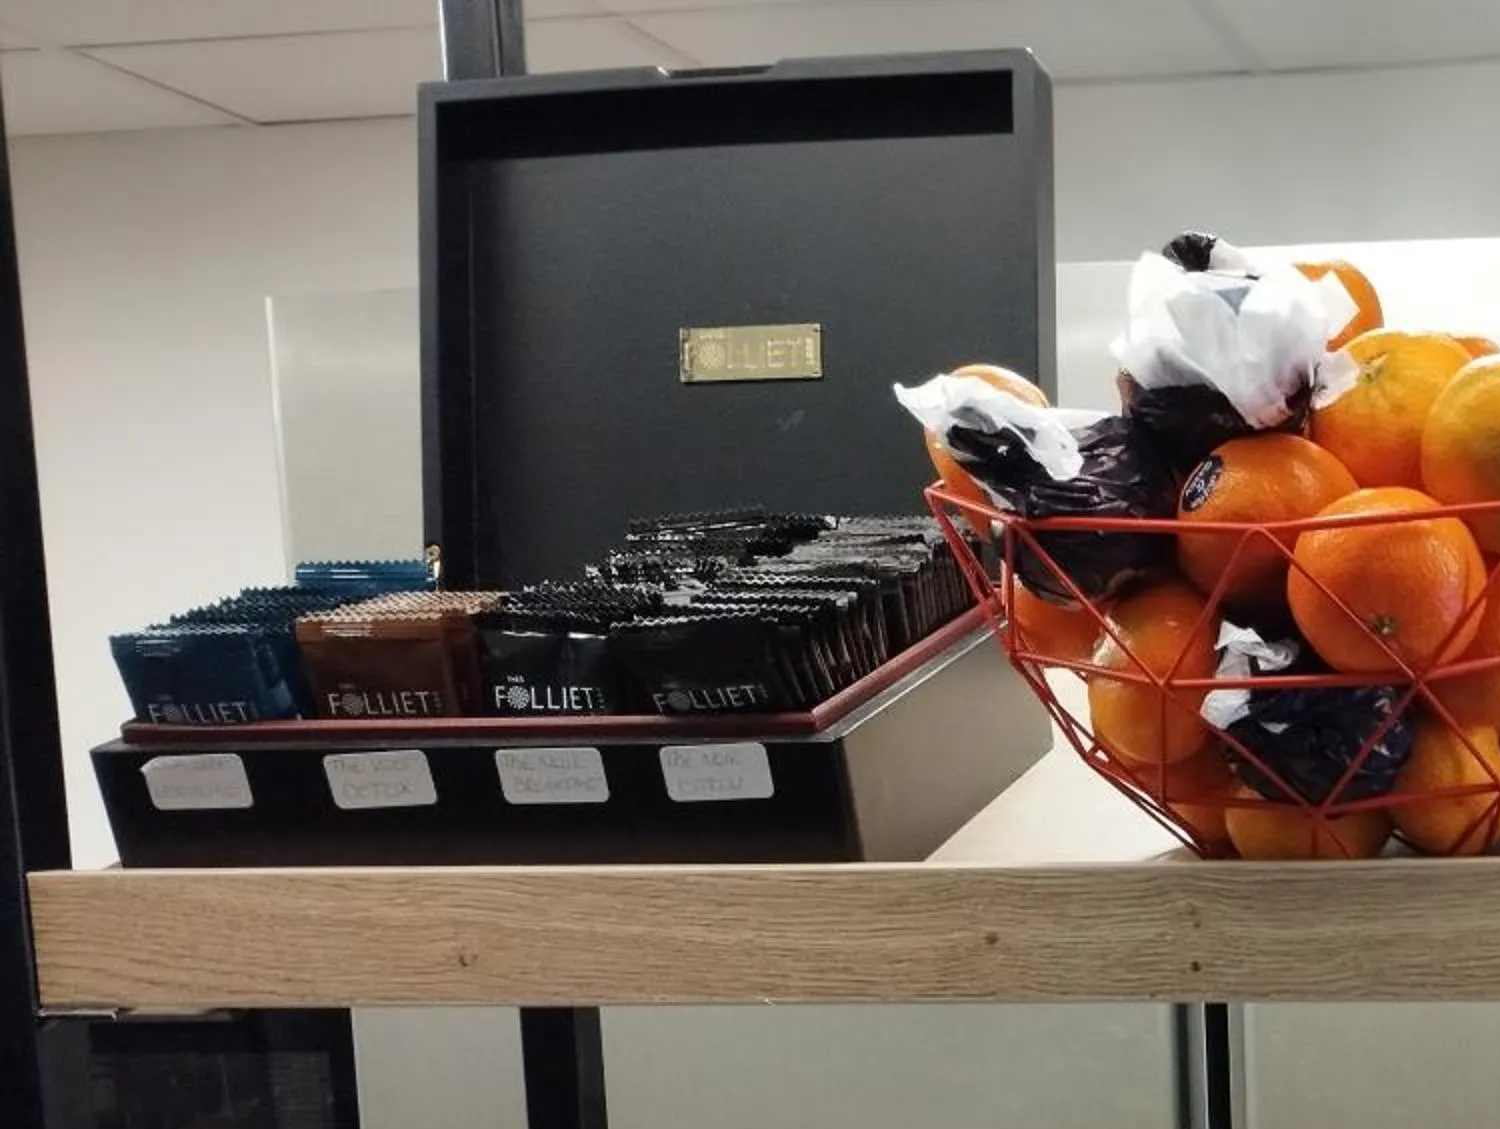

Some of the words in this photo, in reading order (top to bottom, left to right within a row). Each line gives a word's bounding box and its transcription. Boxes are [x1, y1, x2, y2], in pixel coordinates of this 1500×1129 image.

[328, 691, 430, 716] FOLLIET
[495, 685, 593, 710] FOLLIET
[652, 684, 756, 713] FOLLIET
[147, 701, 248, 726] FOLLIET
